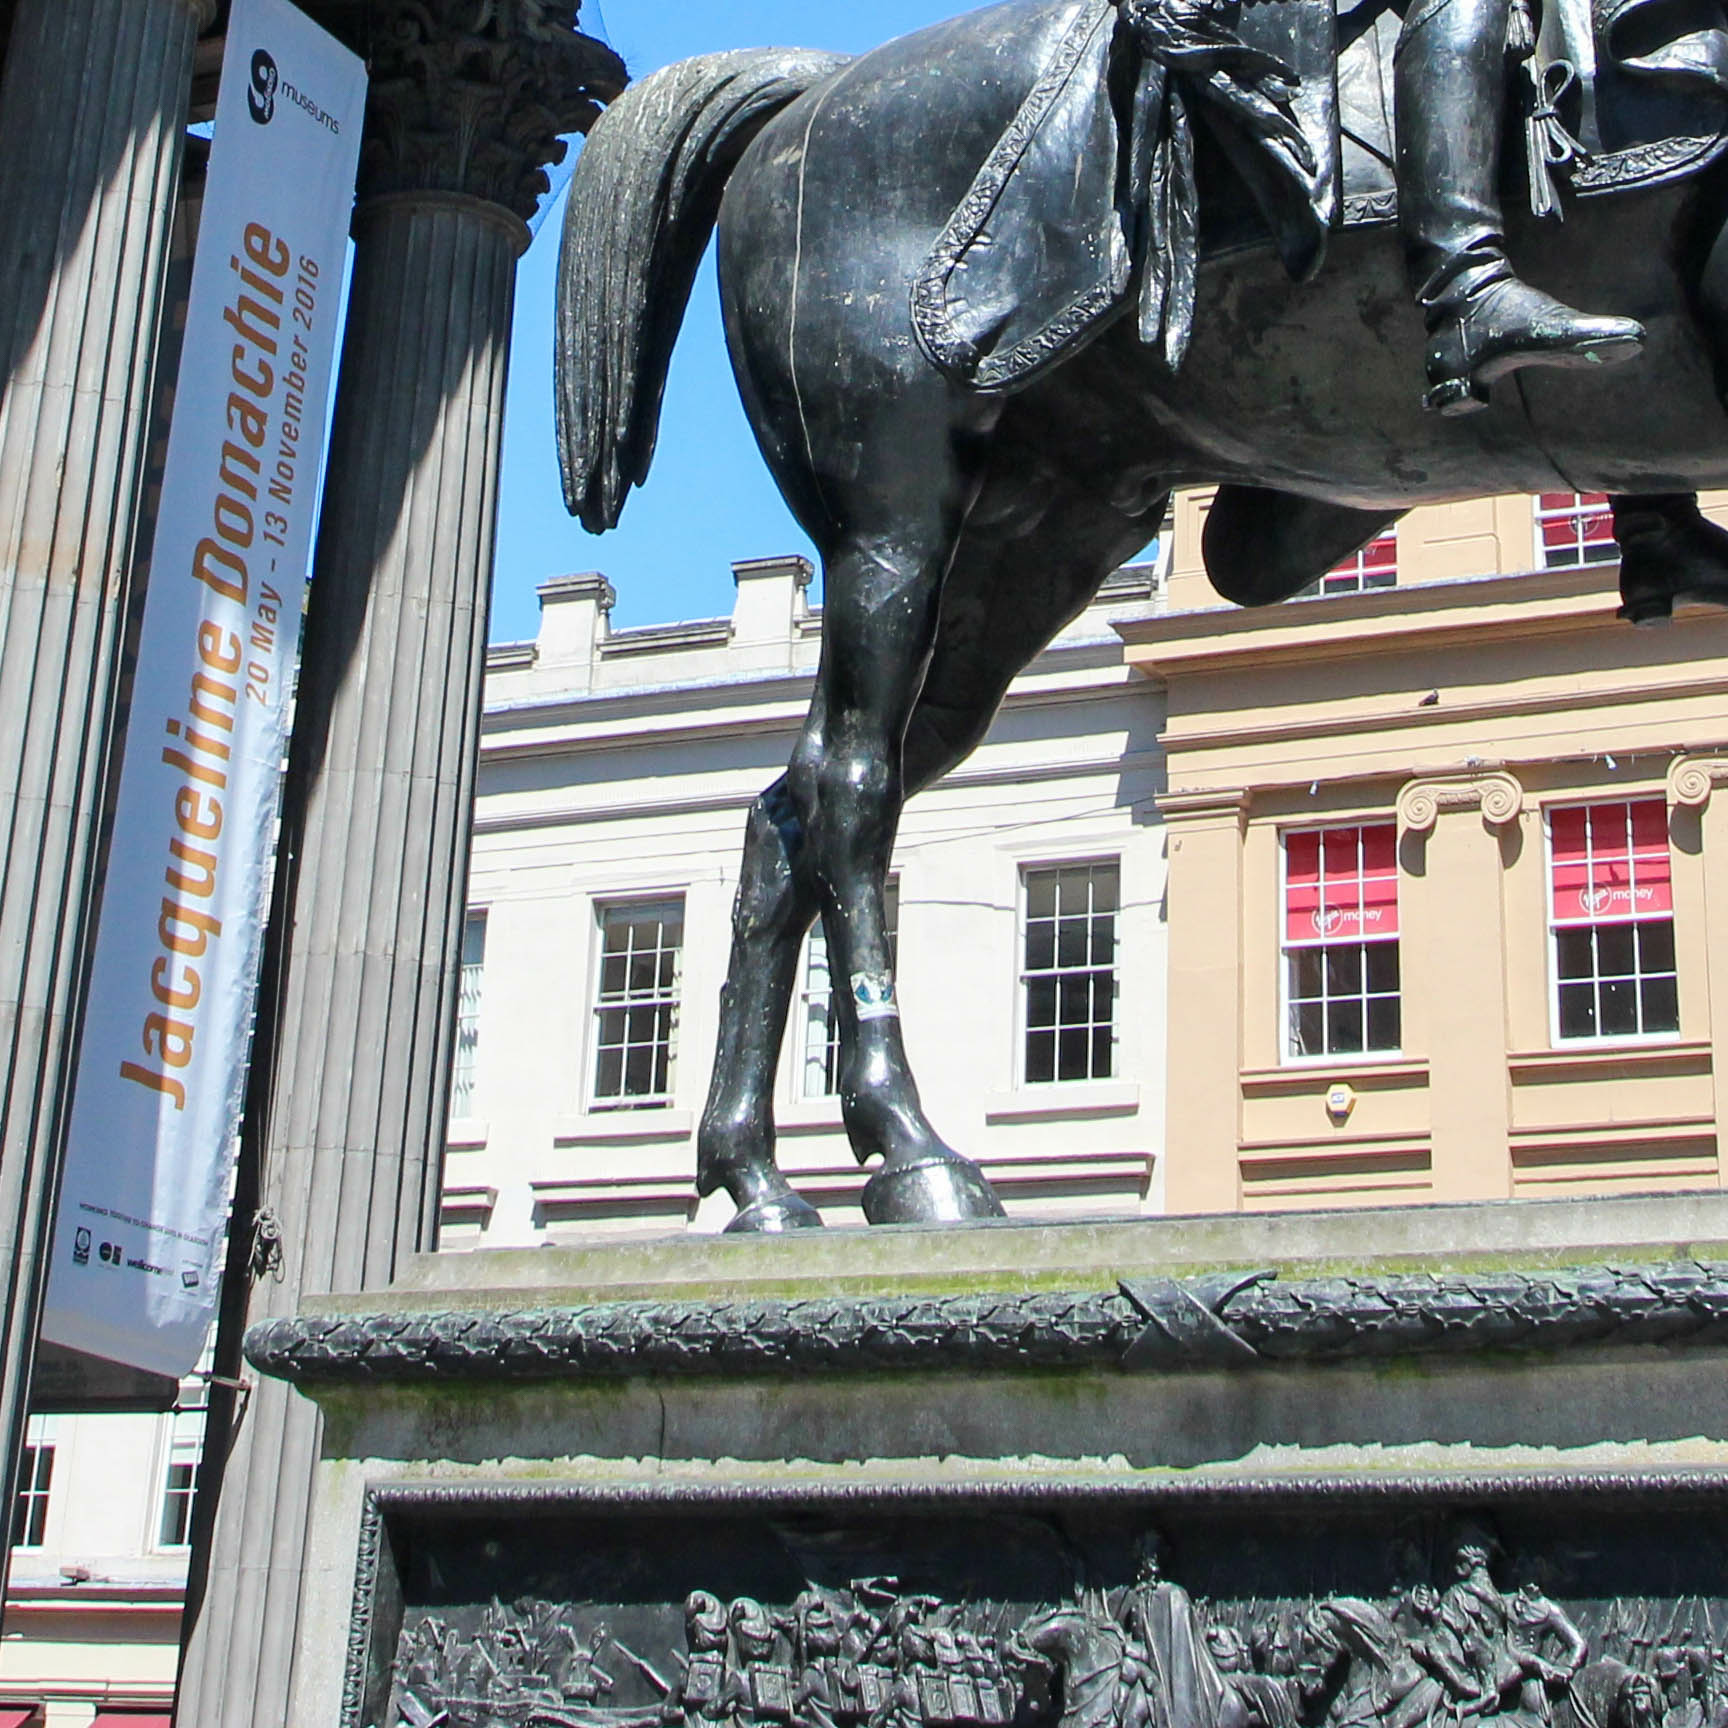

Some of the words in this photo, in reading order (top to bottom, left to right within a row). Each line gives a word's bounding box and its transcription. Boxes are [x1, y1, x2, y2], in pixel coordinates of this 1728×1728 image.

[281, 80, 339, 135] museums
[292, 255, 320, 332] 2016
[268, 333, 308, 506] November
[263, 511, 288, 548] 13
[249, 581, 282, 654] May
[119, 618, 243, 1111] Jacqueline
[191, 221, 290, 607] Donachie
[245, 661, 269, 707] 20
